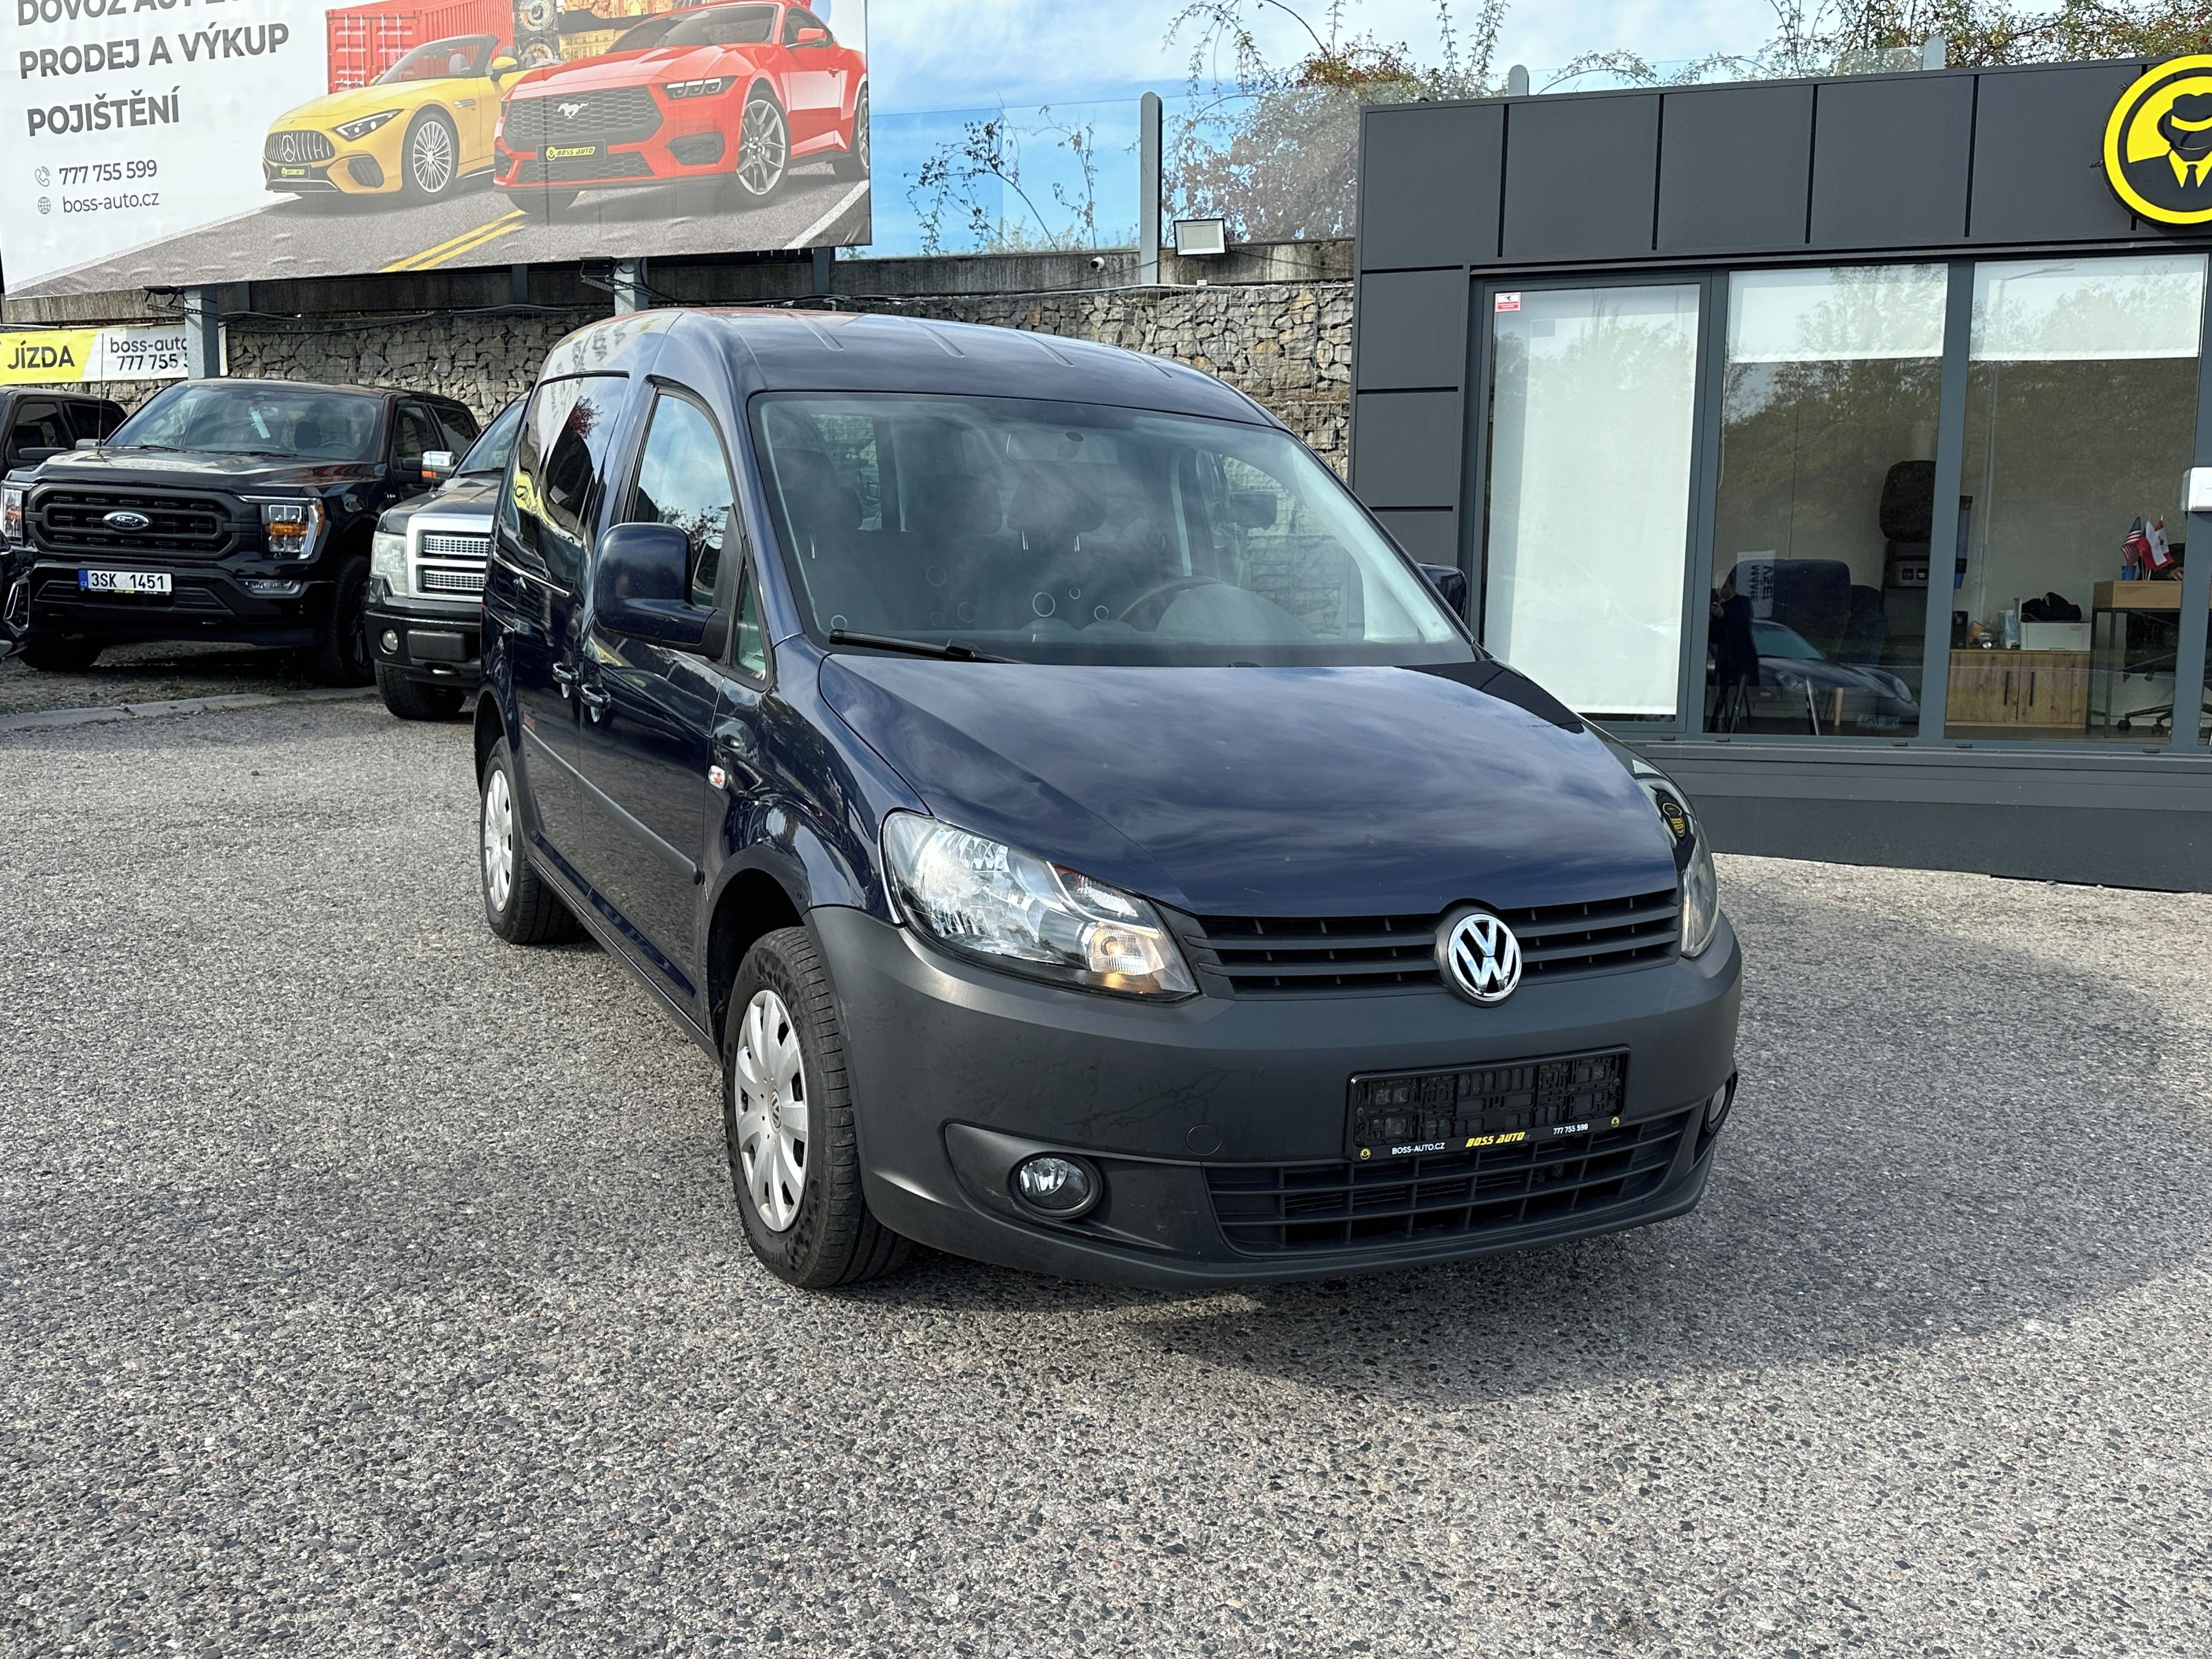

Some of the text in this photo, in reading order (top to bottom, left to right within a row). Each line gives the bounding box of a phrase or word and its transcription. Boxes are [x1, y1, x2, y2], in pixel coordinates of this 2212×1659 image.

[20, 22, 289, 79] PRODEJ A VÝKUP
[27, 86, 180, 136] POJIŠTĚNÍ
[59, 159, 157, 185] 777 755 599
[63, 193, 160, 213] boss-auto.cz
[7, 340, 75, 369] JÍZDA
[117, 355, 144, 371] 777
[148, 353, 178, 370] 755
[91, 572, 164, 589] 3SK 1451
[1553, 1123, 1589, 1135] 777 755 599
[1392, 1142, 1446, 1155] BOSS-AUTO.CZ
[1465, 1135, 1495, 1148] BOSS
[1495, 1131, 1526, 1144] AUTO
